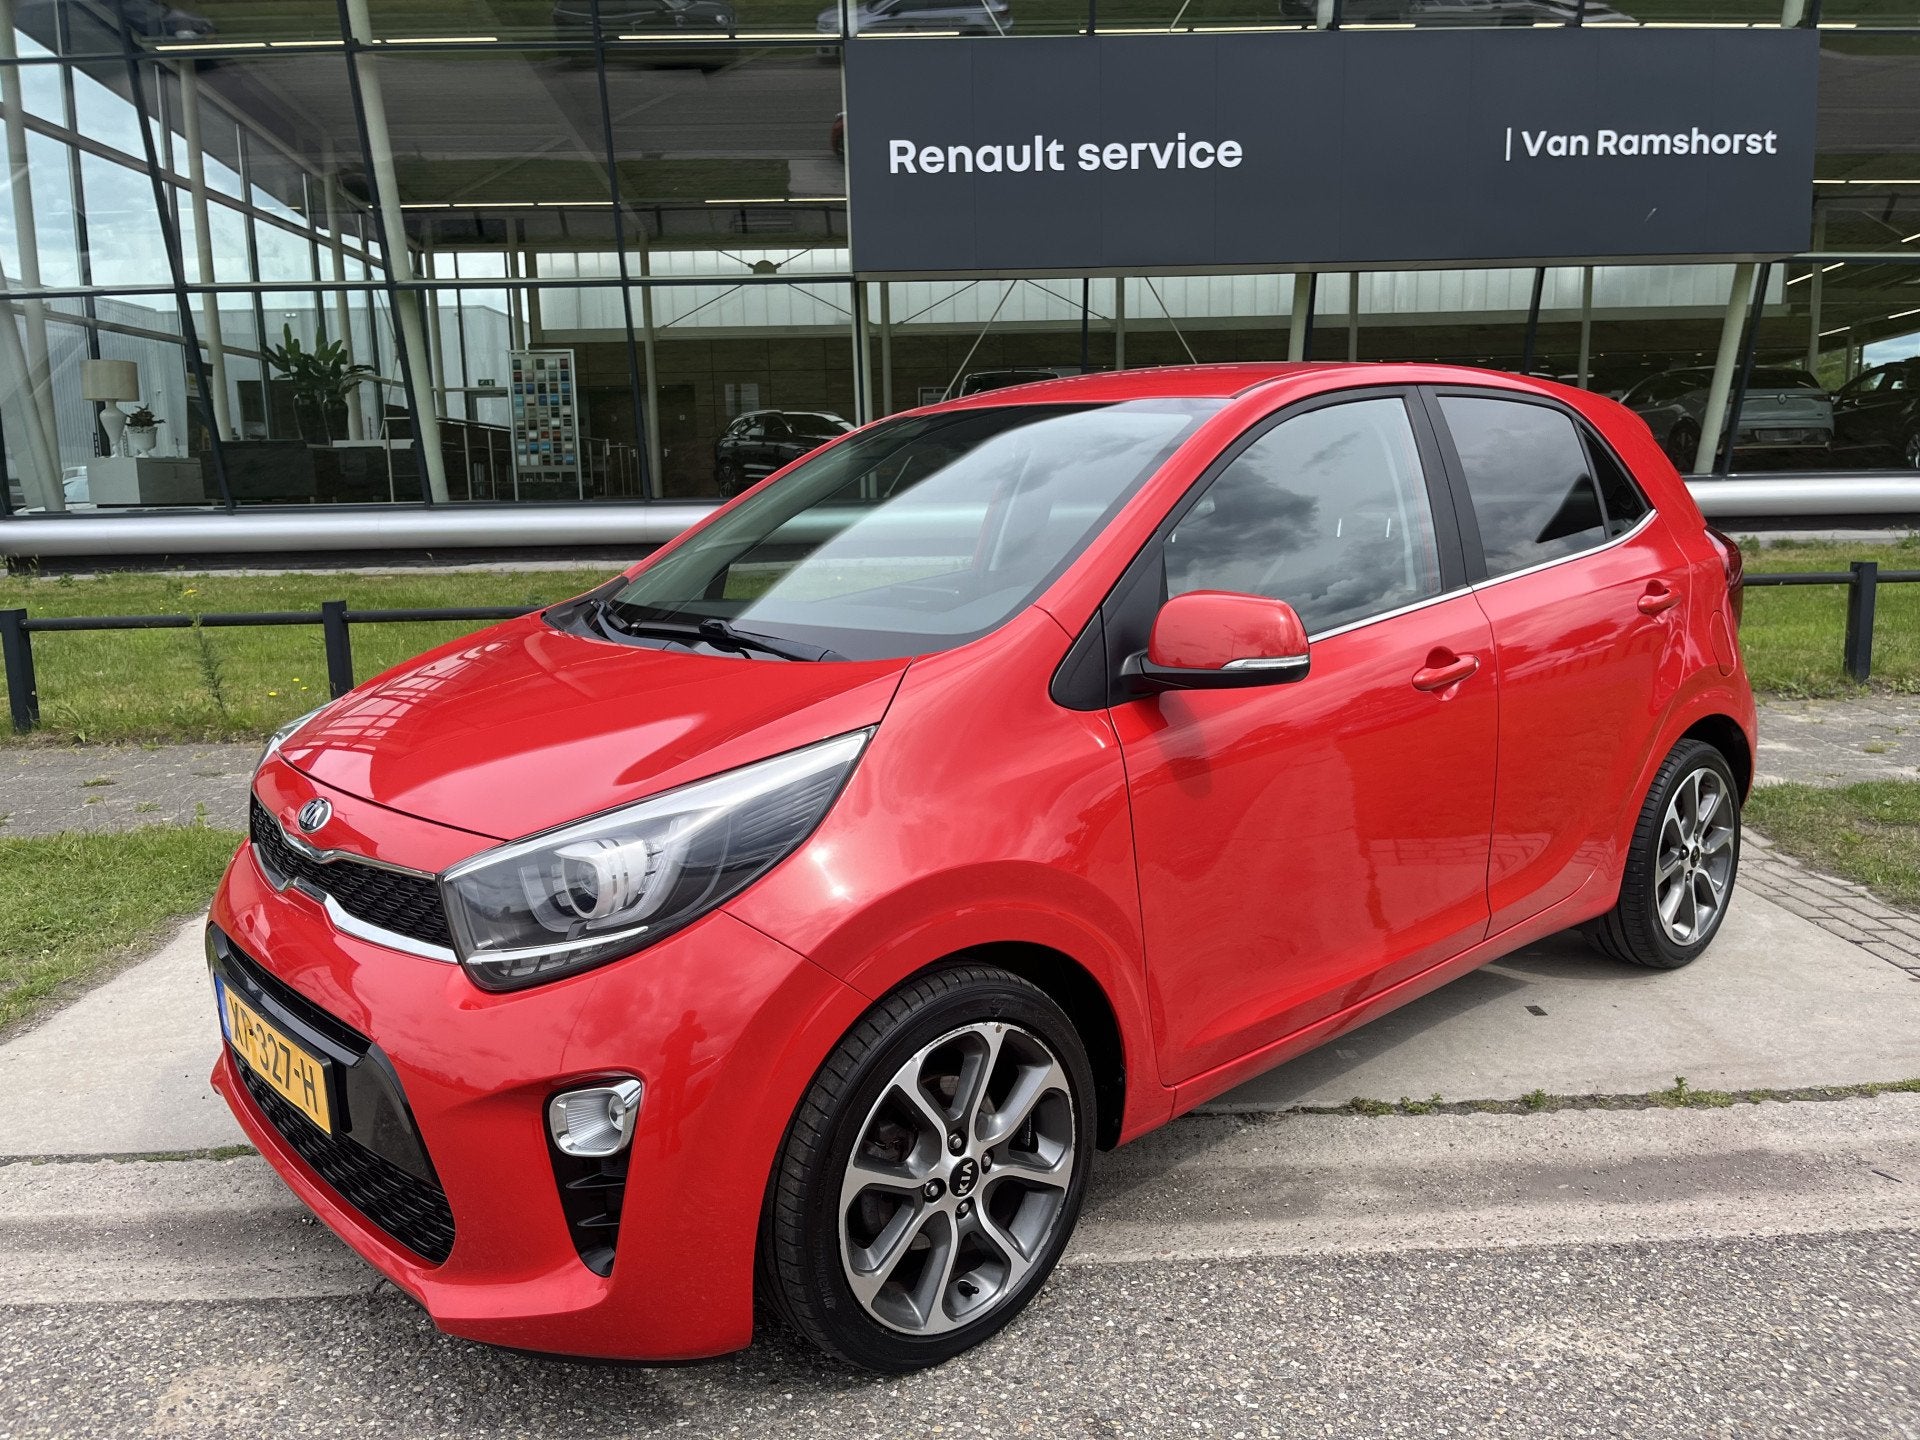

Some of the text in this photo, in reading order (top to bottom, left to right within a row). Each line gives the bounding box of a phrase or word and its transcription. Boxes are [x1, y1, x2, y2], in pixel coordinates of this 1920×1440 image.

[890, 133, 1242, 173] Renault service
[1522, 127, 1777, 156] Van Ramshorst
[957, 1161, 973, 1194] KIA
